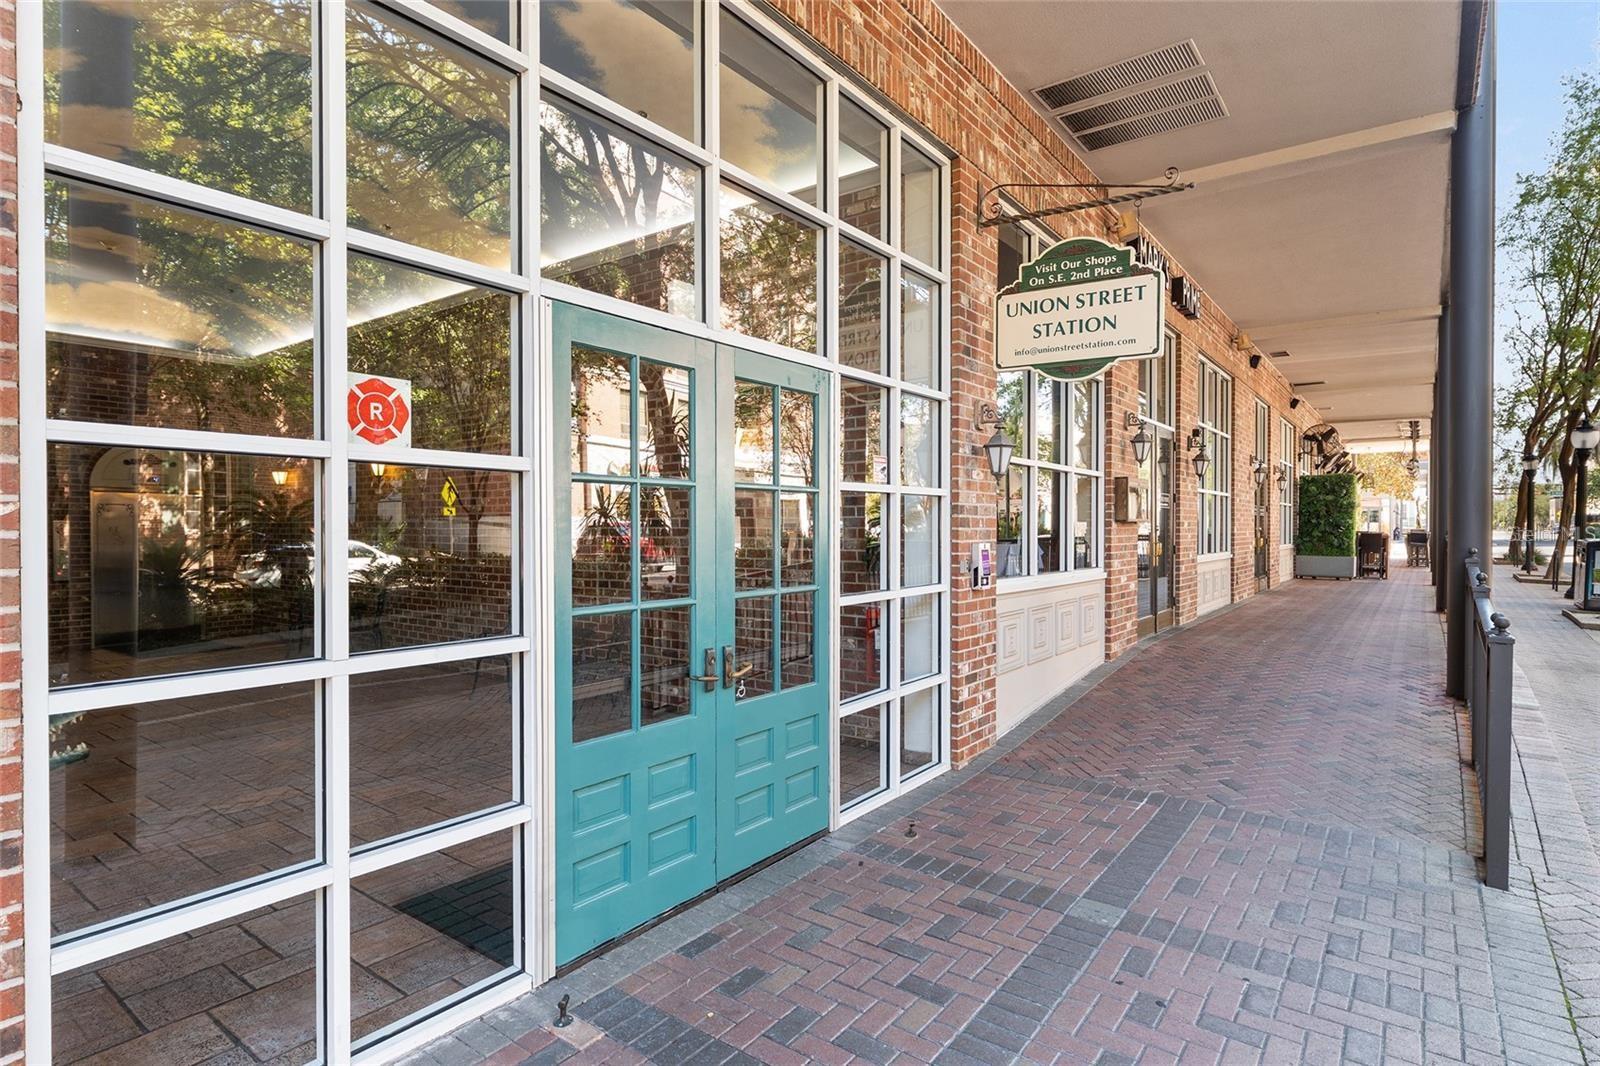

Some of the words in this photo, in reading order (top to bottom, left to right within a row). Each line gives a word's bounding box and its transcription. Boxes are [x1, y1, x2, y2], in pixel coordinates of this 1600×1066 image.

[1035, 262, 1057, 274] Visit
[1060, 259, 1081, 270] Our
[1085, 254, 1117, 266] Shops
[1029, 276, 1045, 287] On
[1048, 273, 1066, 285] S.E.
[1070, 269, 1090, 281] 2nd
[1095, 265, 1123, 277] Place
[1006, 296, 1070, 318] UNION
[1075, 285, 1147, 309] STREET
[1033, 315, 1117, 339] STATION
[1014, 337, 1136, 356] info@unionstreetstation.com
[369, 402, 384, 421] R
